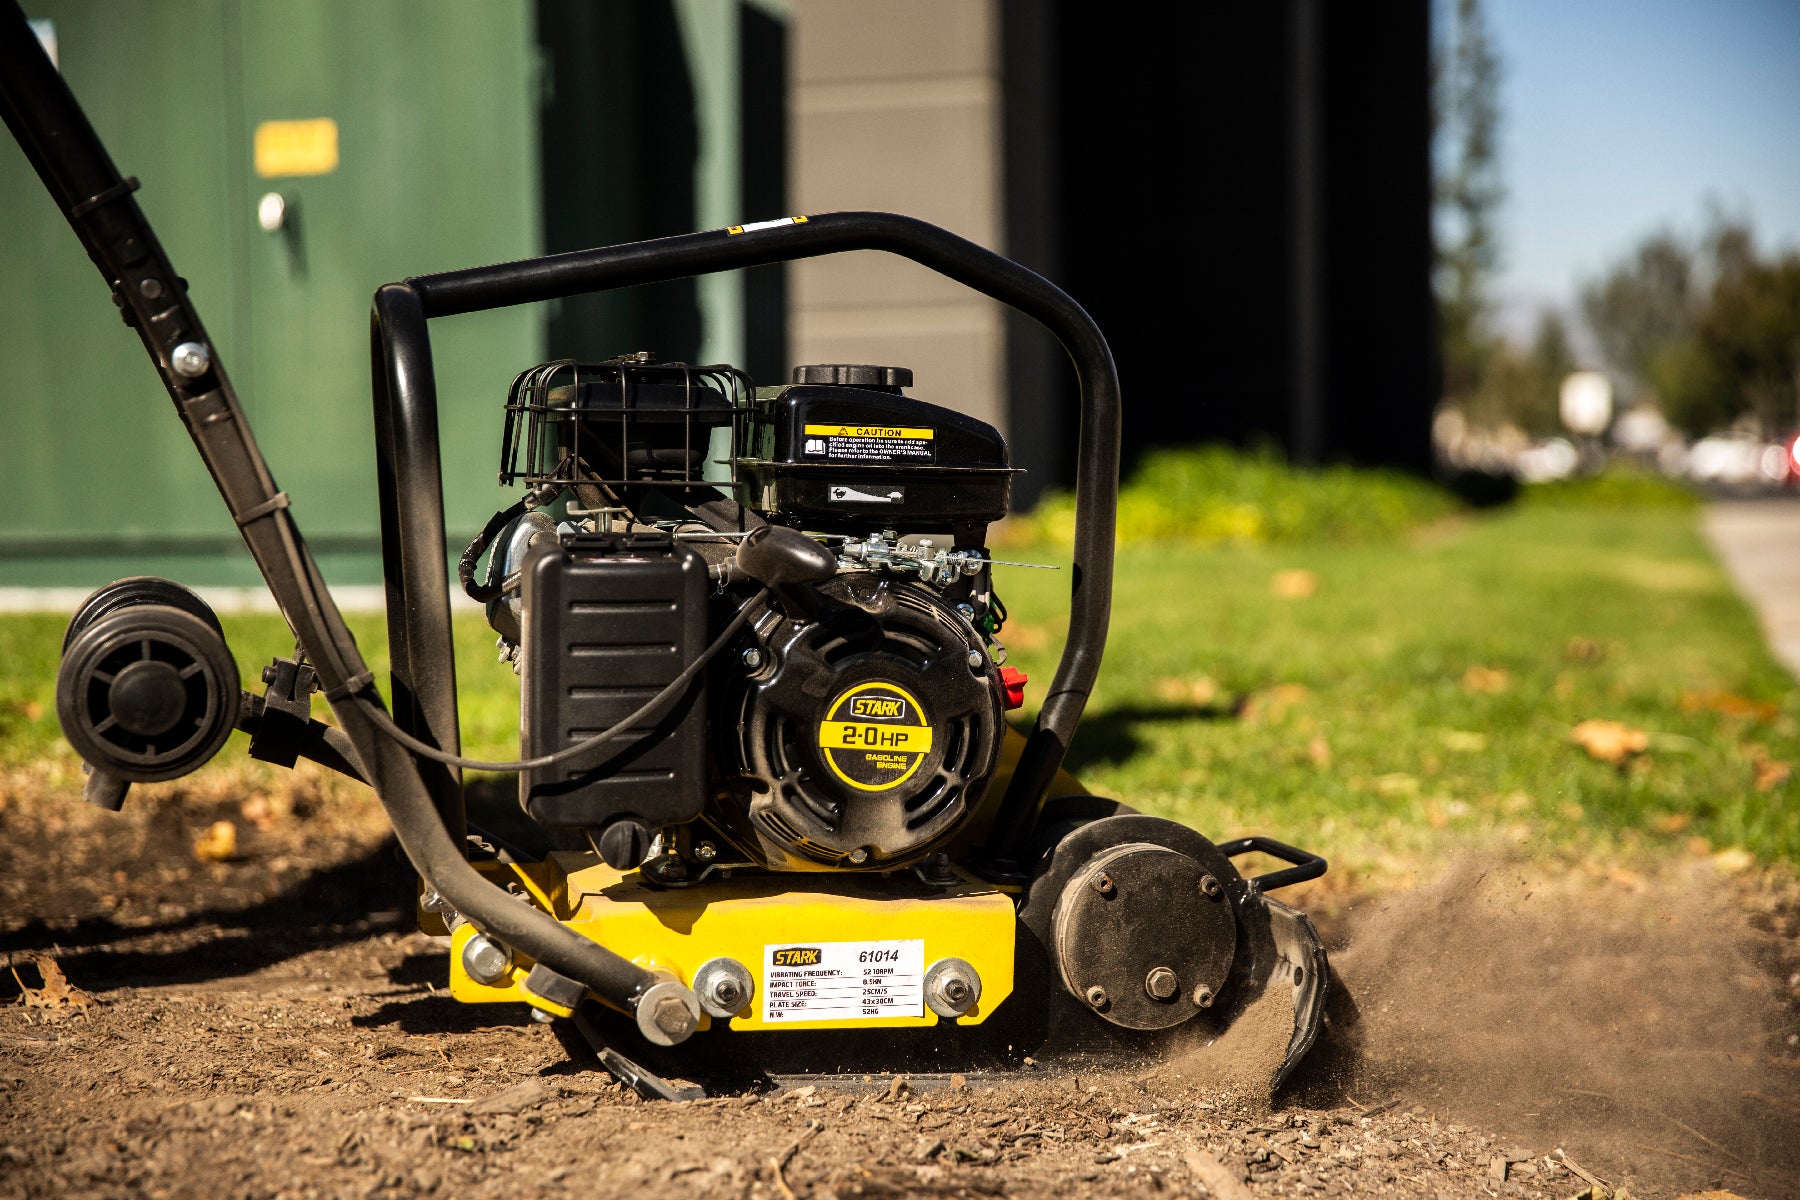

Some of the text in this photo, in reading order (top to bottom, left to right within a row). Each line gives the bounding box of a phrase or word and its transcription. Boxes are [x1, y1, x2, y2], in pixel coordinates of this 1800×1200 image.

[856, 428, 902, 437] CAUTION
[854, 699, 902, 716] STARK
[865, 753, 908, 763] GASOLINE
[876, 761, 907, 770] ENGINE
[775, 949, 819, 965] STARK
[859, 949, 899, 963] 61014
[803, 969, 843, 977] FREQUENCY:
[795, 990, 818, 998] SPEED:
[790, 1000, 807, 1008] SIZE:
